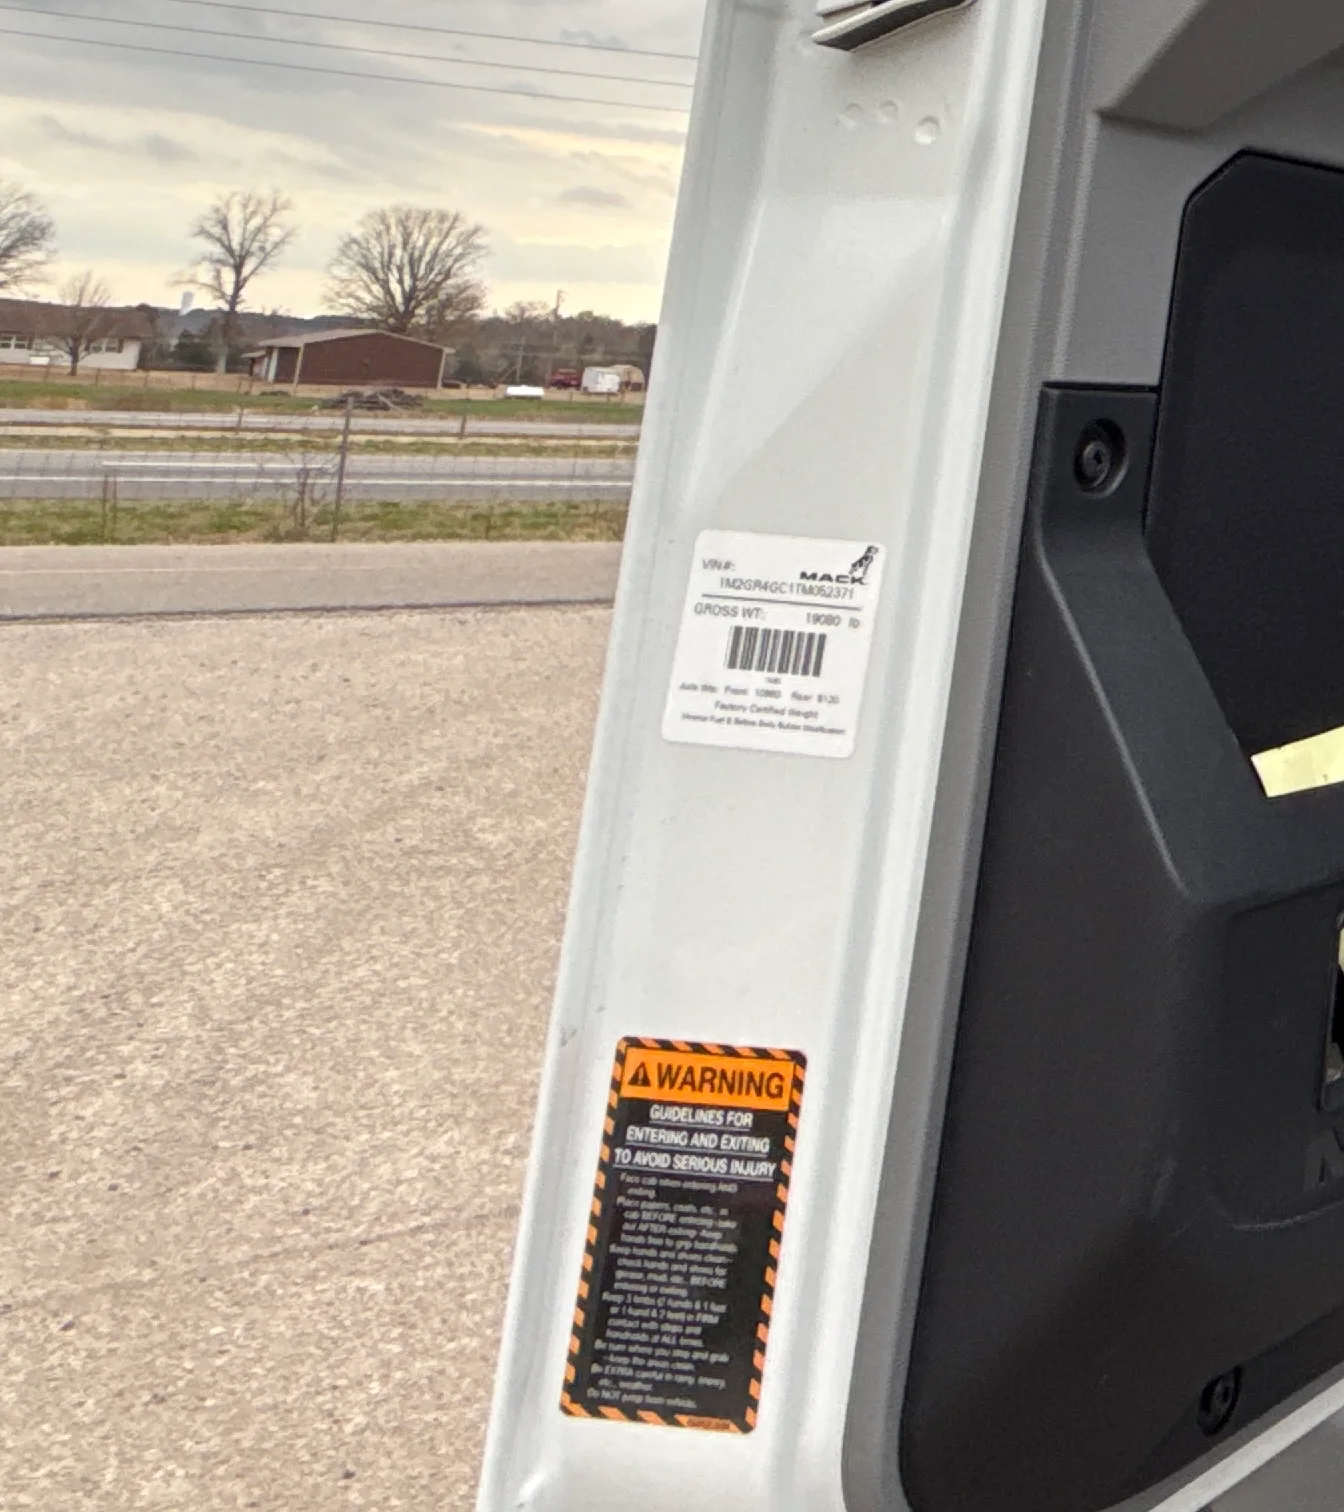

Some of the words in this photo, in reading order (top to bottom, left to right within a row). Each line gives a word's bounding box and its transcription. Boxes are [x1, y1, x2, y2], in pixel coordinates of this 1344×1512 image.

[800, 571, 867, 585] MACK
[693, 602, 739, 618] GROSS
[848, 617, 861, 629] lb
[653, 1062, 786, 1099] WARNING
[649, 1104, 725, 1125] GUIDELINES
[726, 1111, 754, 1127] FOR
[626, 1125, 689, 1146] ENTERING
[690, 1131, 719, 1148] AND
[720, 1134, 770, 1152] EXITING
[613, 1148, 632, 1163] TO
[633, 1150, 672, 1168] AVOID
[673, 1154, 728, 1173] SERIOUS
[730, 1159, 776, 1176] INJURY
